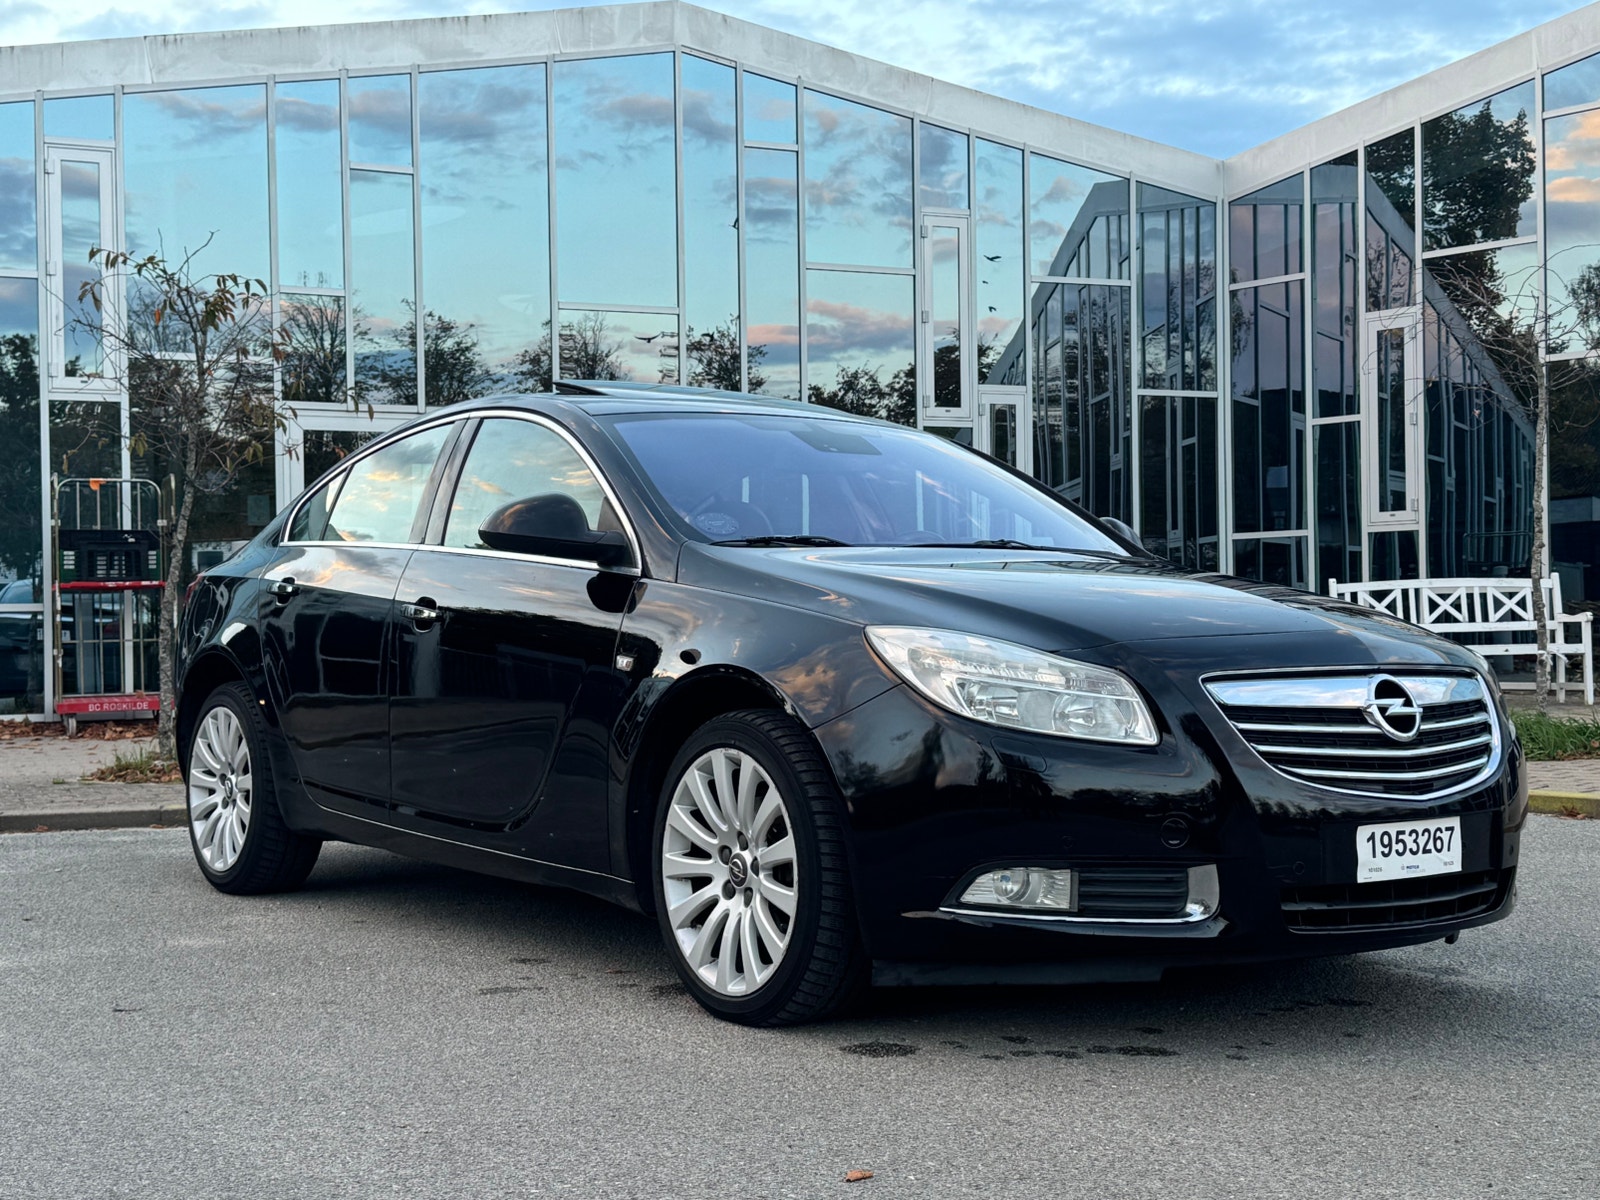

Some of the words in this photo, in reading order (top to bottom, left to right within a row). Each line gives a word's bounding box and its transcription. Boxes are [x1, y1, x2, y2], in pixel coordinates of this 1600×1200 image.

[88, 703, 101, 712] BC
[103, 702, 149, 711] ROSKILDE
[1366, 826, 1455, 859] 1953267
